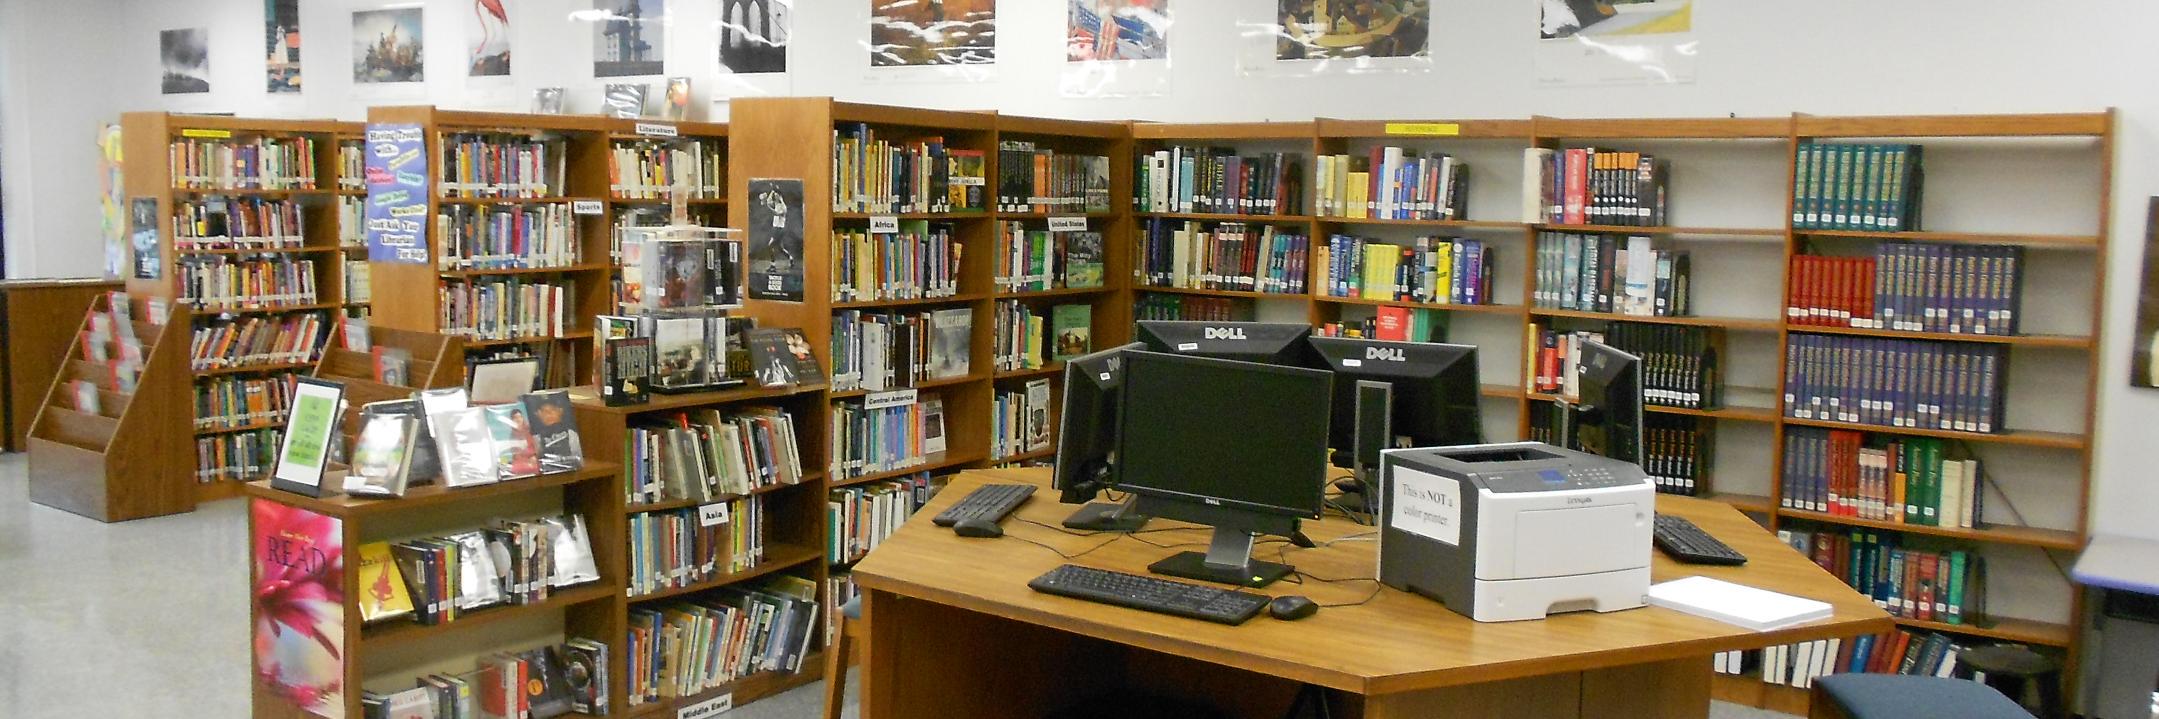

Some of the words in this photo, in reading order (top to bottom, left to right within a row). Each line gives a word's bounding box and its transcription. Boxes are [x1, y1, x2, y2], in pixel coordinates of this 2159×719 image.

[639, 126, 675, 135] Literature
[1216, 164, 1224, 191] BIBLE
[576, 203, 601, 211] Sports
[874, 220, 895, 229] Africa
[382, 234, 416, 244] Librarian
[1205, 327, 1247, 340] DELL
[1366, 346, 1406, 362] DELL
[868, 396, 891, 404] Central
[891, 394, 914, 402] America
[1402, 483, 1418, 499] This
[1427, 489, 1447, 505] NOT
[705, 511, 723, 521] Asia
[1403, 504, 1422, 518] color
[266, 535, 328, 577] READ
[682, 705, 709, 719] Middle
[711, 699, 729, 710] East
